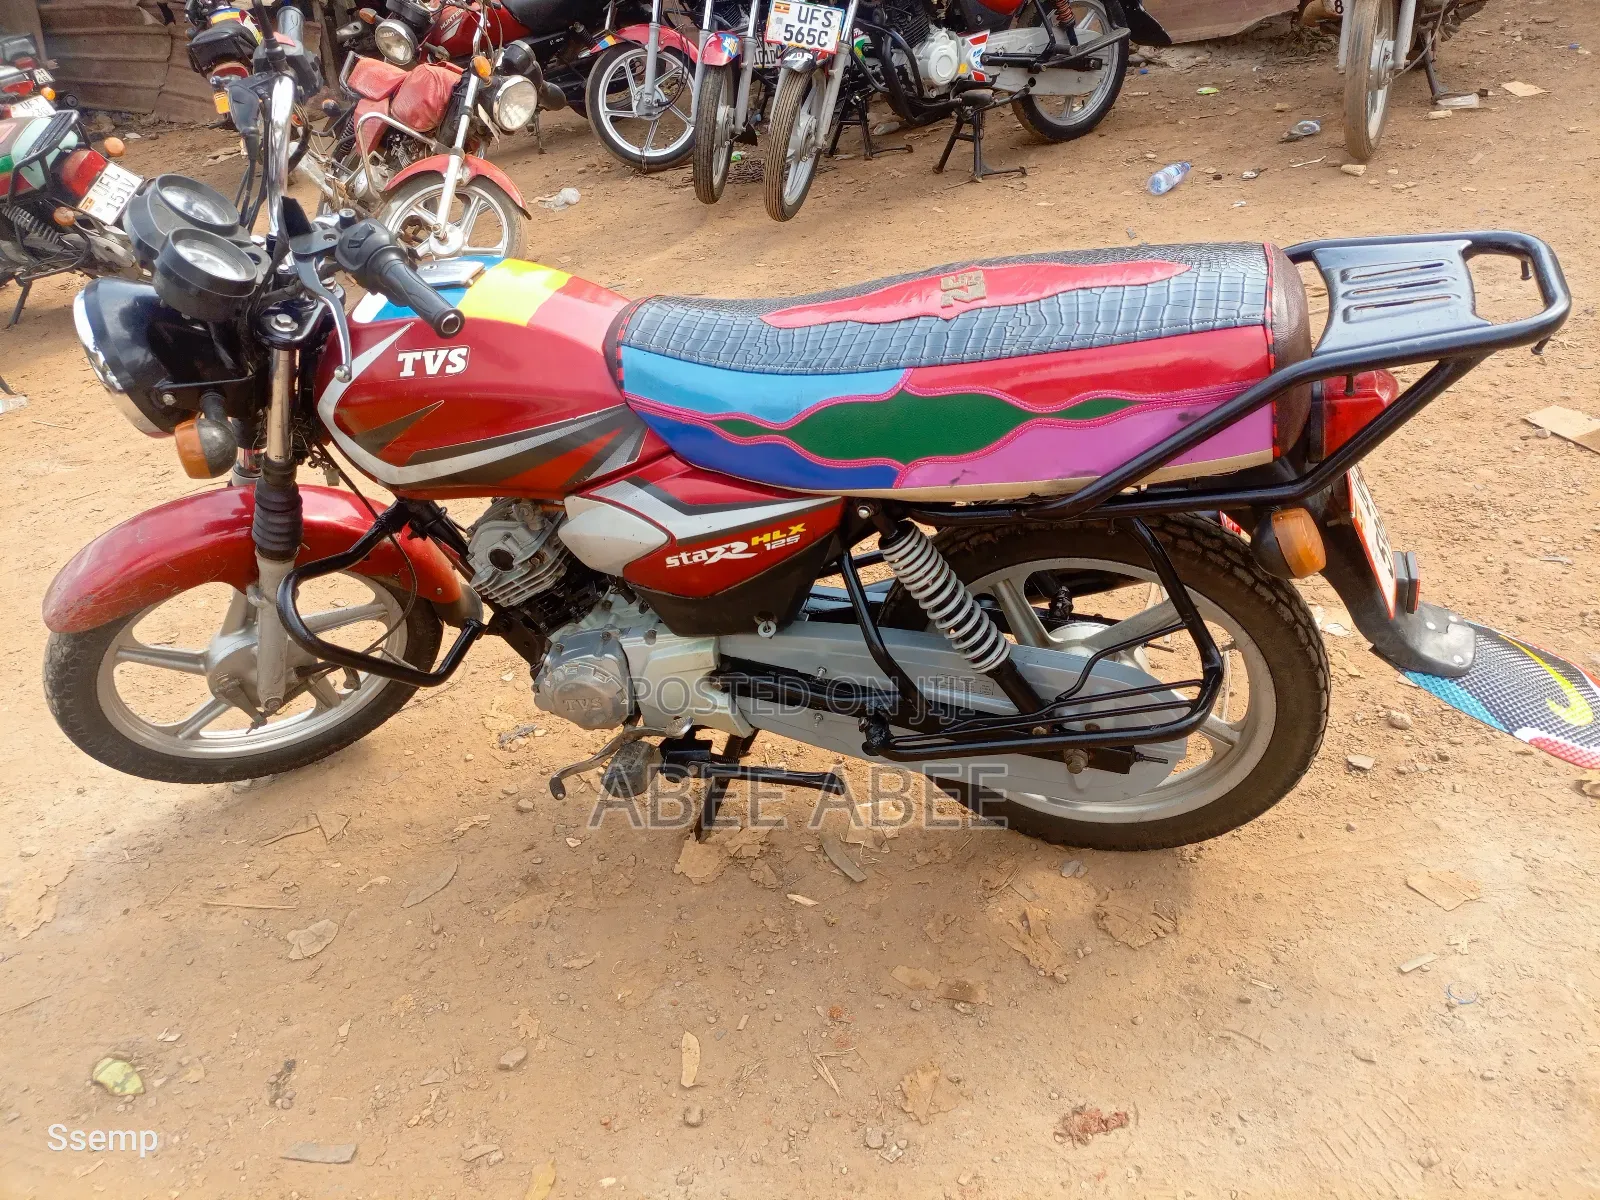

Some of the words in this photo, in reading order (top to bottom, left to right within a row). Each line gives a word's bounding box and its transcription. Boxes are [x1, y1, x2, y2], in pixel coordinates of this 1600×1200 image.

[440, 8, 465, 30] HUNTER
[797, 6, 834, 28] UFS
[783, 24, 829, 48] 565C
[92, 173, 121, 196] UFL
[106, 178, 135, 211] 151V
[397, 348, 468, 377] TVS
[751, 522, 807, 546] HLX
[764, 534, 801, 551] 125
[562, 697, 603, 712] TVS
